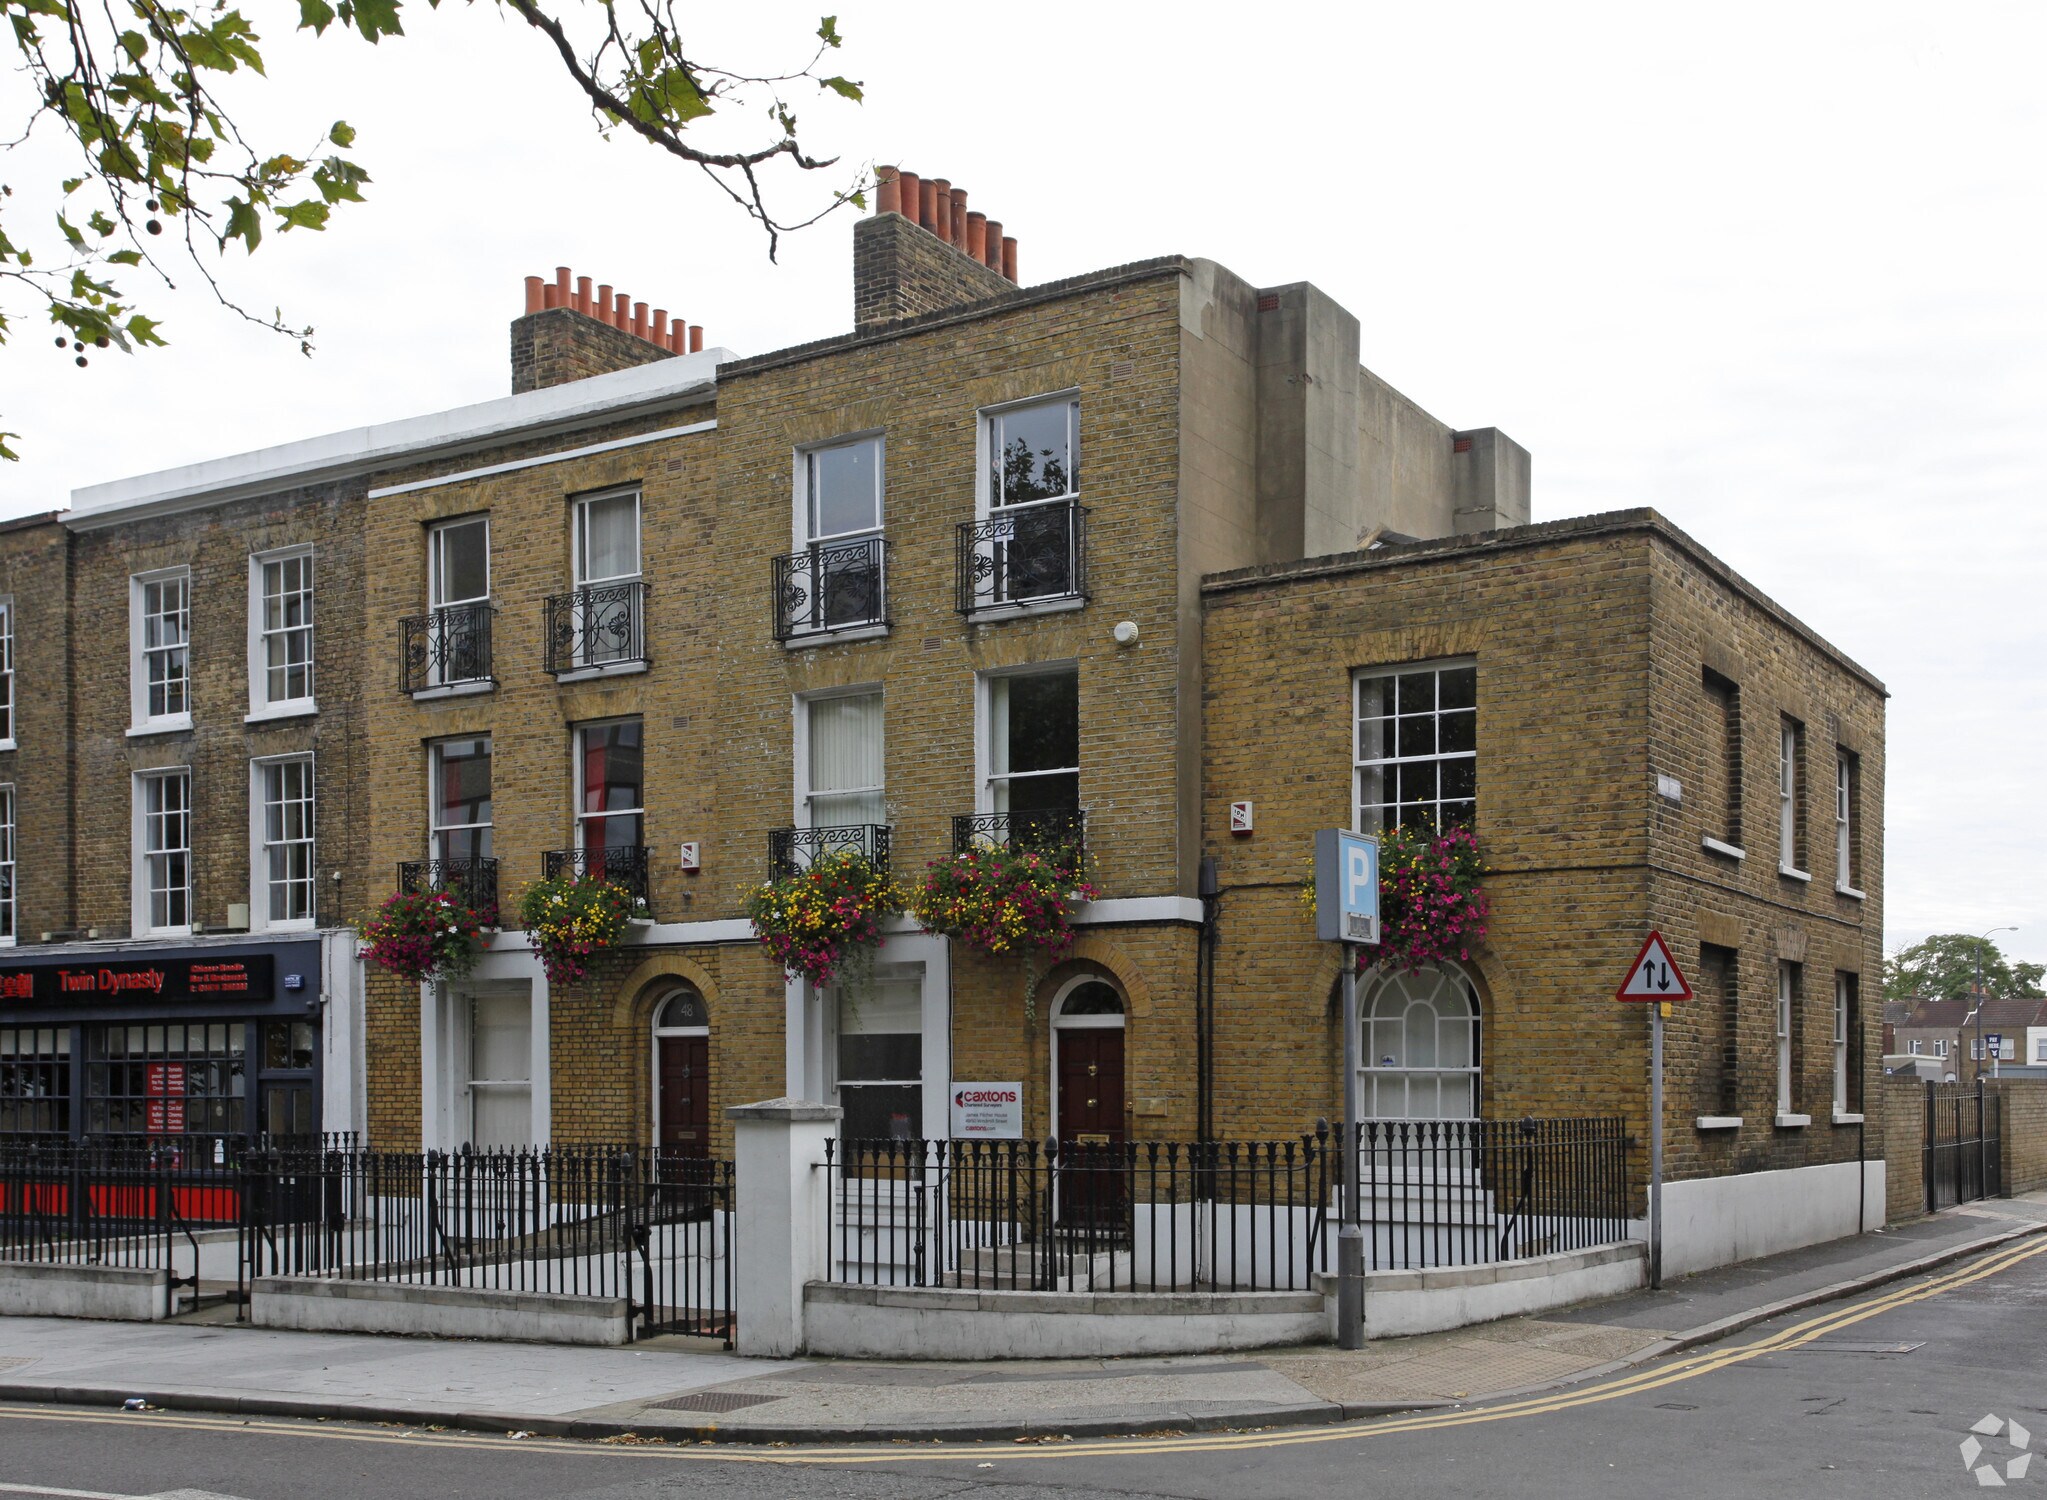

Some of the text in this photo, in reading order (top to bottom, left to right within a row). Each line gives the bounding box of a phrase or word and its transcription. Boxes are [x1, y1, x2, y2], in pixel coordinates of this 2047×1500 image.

[1348, 846, 1369, 906] P
[58, 968, 165, 995] Twin Dynasty
[681, 1004, 694, 1017] 48
[964, 1090, 1017, 1102] caxtons
